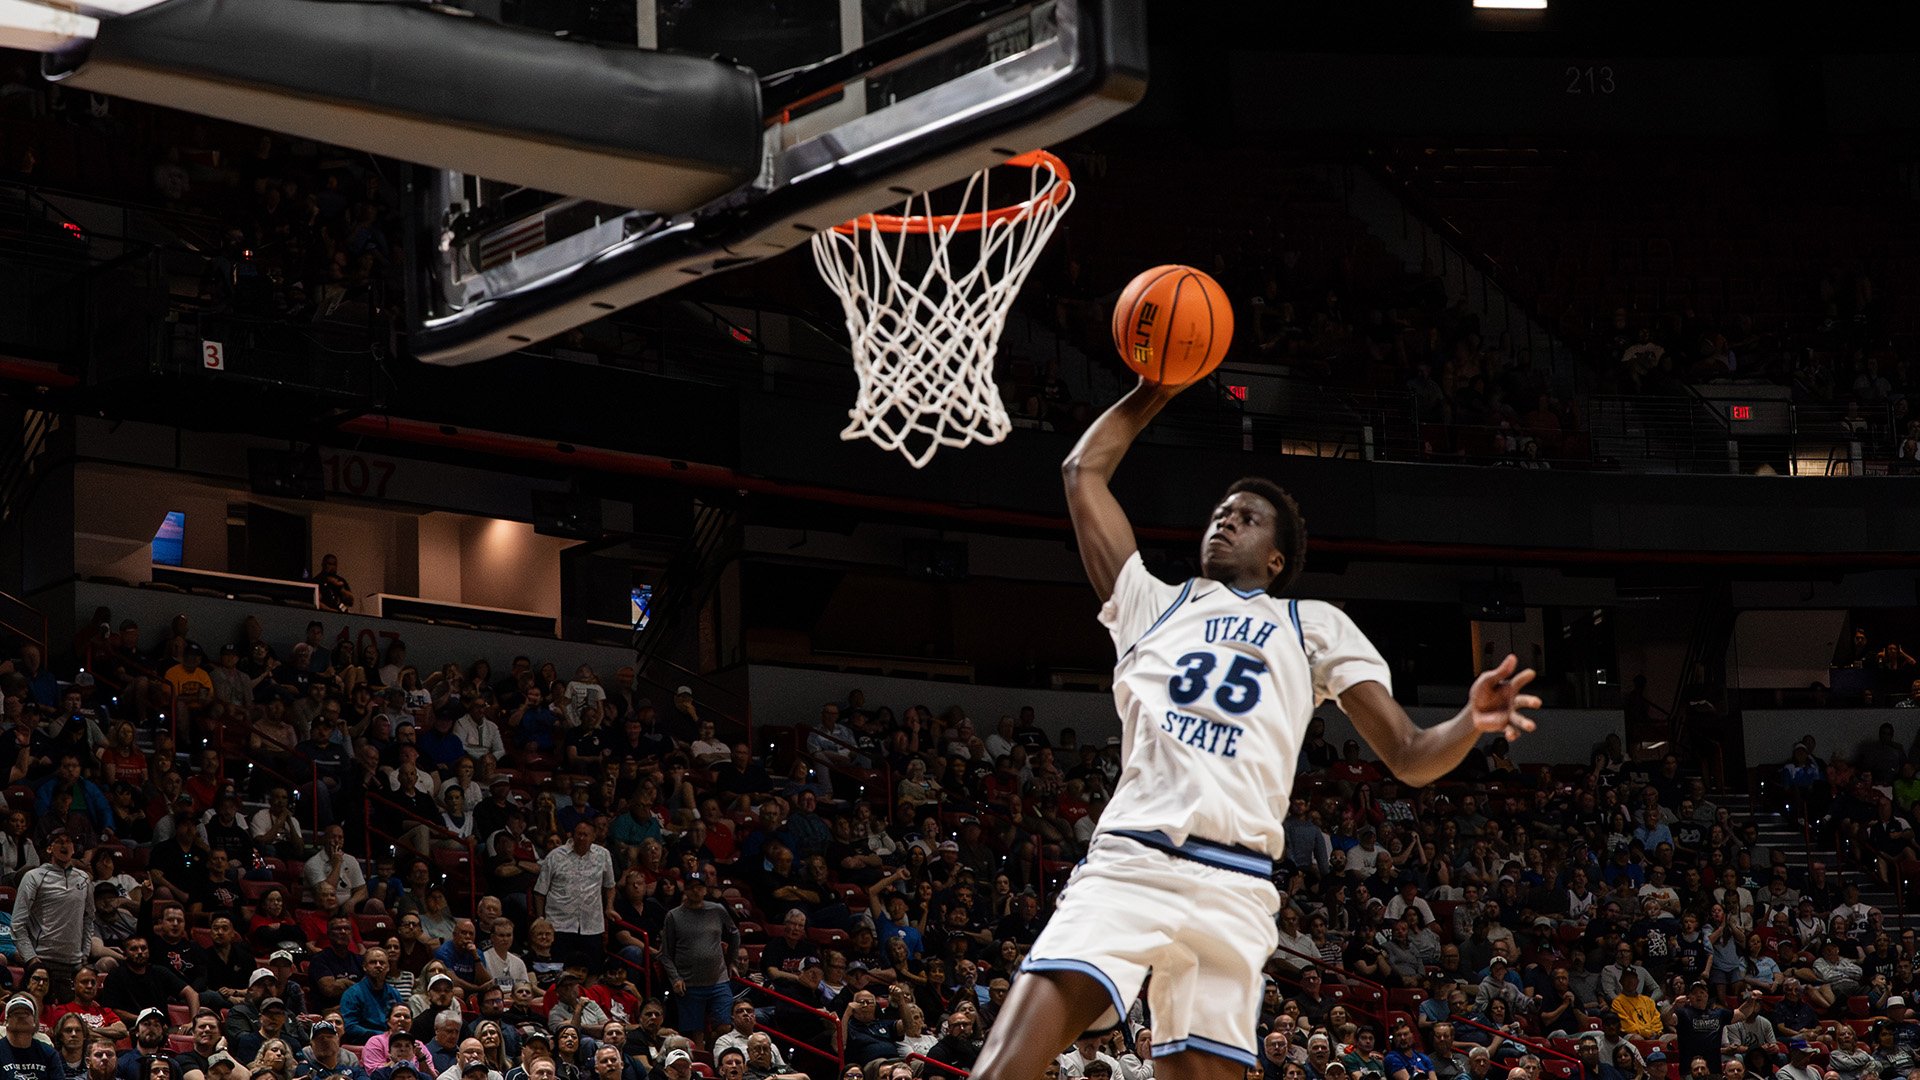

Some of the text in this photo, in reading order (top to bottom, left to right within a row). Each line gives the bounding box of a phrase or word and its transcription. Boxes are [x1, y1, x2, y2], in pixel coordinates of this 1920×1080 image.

[1566, 66, 1615, 95] 213
[1133, 302, 1159, 364] ELITE
[206, 345, 219, 367] 3
[1734, 405, 1750, 419] EXIT
[325, 455, 396, 496] 107
[1205, 617, 1278, 648] UTAH
[1169, 651, 1268, 714] 35
[1161, 711, 1244, 757] STATE
[21, 1063, 47, 1072] STATE
